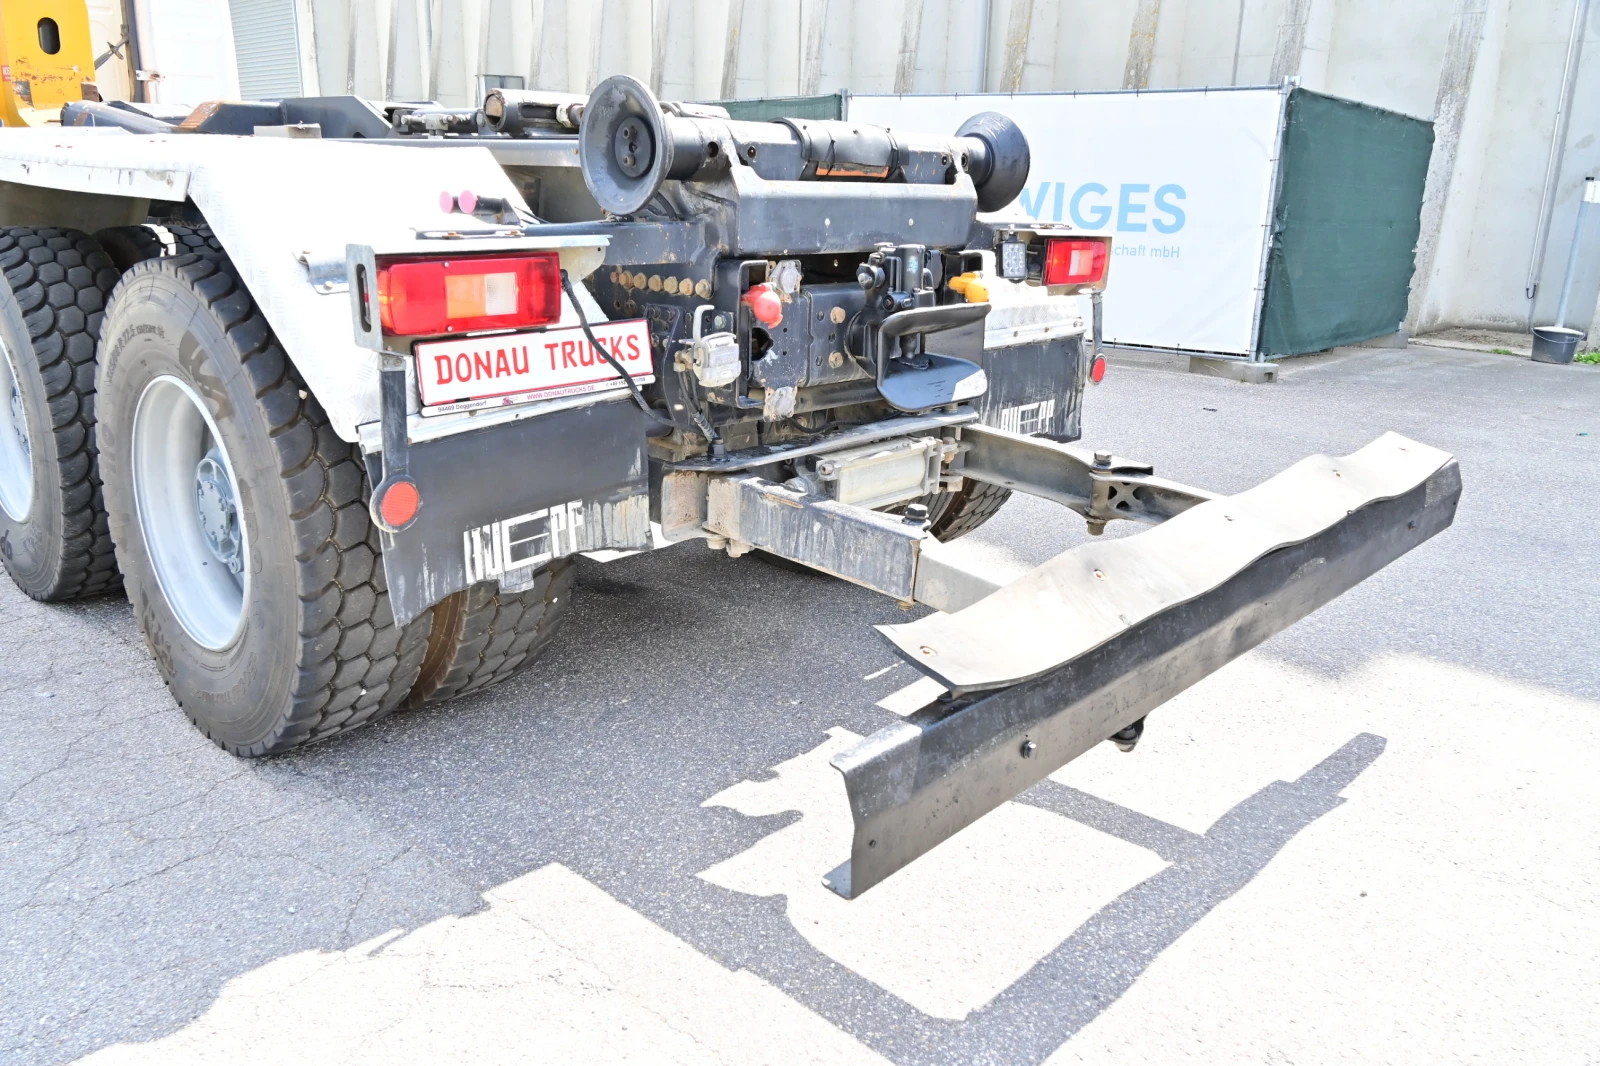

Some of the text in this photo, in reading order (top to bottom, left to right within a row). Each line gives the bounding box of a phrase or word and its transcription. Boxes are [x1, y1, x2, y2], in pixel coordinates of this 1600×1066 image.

[1150, 246, 1180, 258] mbH
[433, 333, 641, 385] DONAU TRUCKS
[526, 384, 595, 400] WWW.DONAUTRUCKS.DE
[455, 400, 487, 411] Deggendorf
